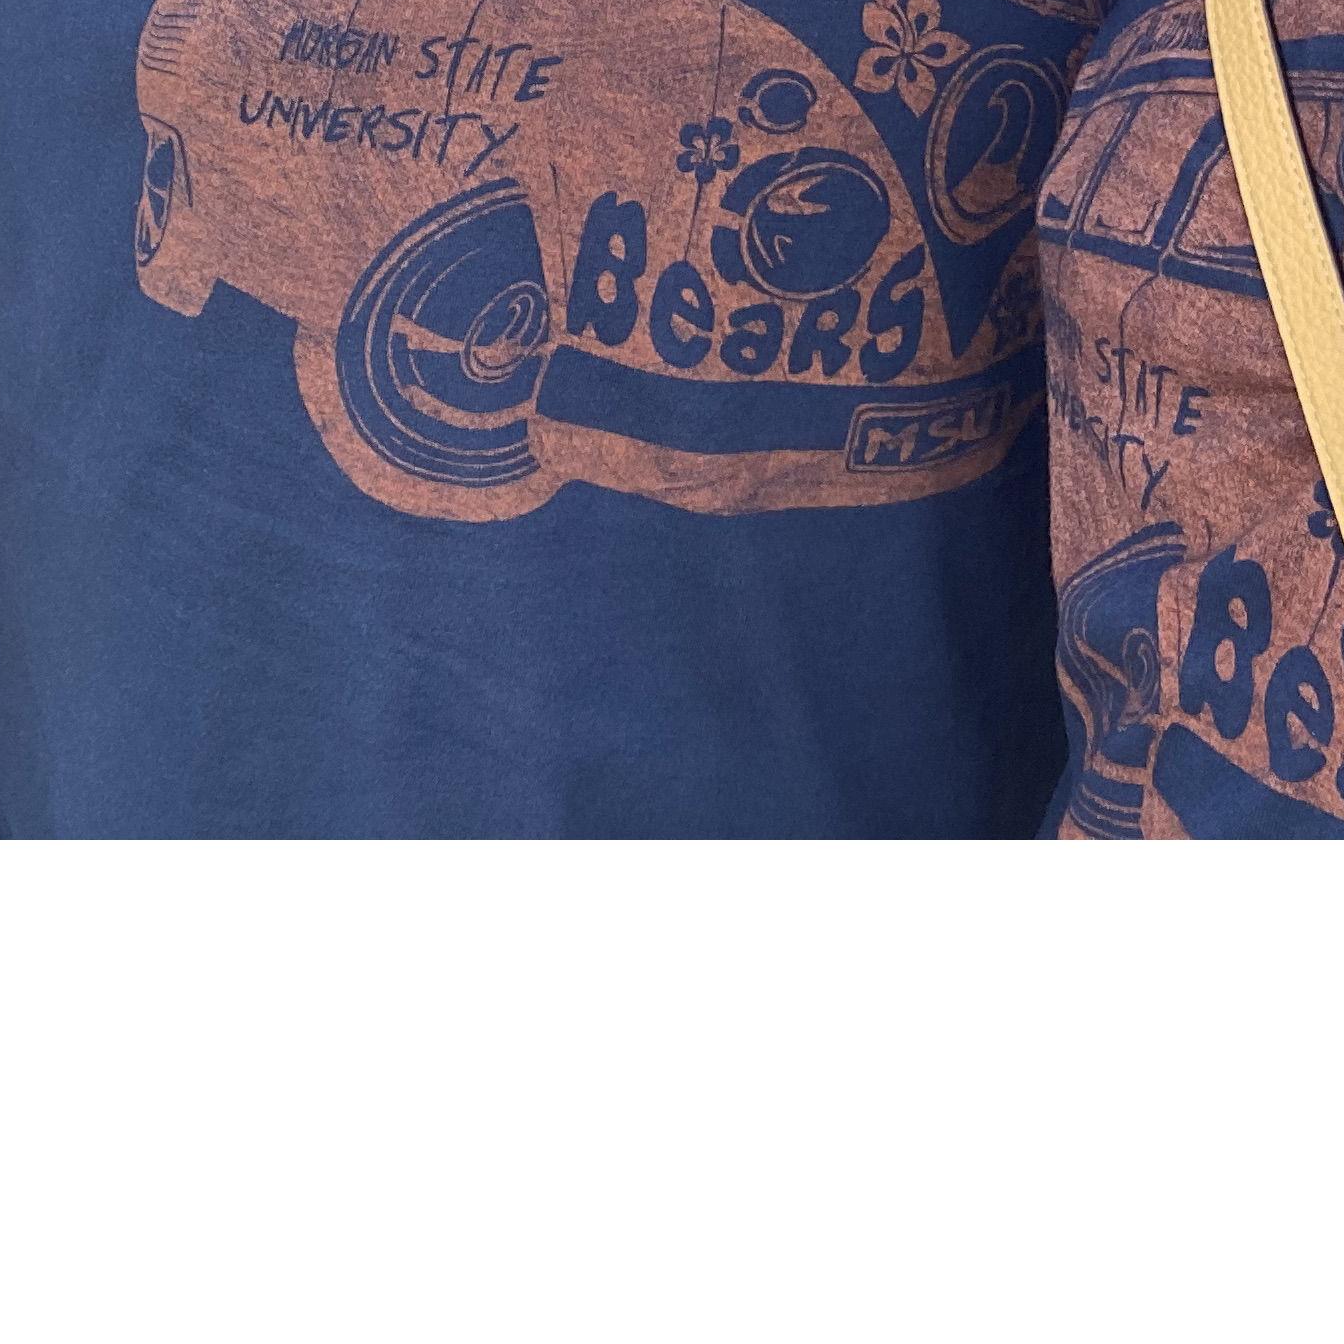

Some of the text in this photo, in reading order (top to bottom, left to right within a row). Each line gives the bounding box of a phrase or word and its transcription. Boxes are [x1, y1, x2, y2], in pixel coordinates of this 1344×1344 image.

[415, 35, 565, 102] STATE
[239, 90, 520, 178] UNIVERSITY
[1094, 336, 1212, 436] STATE
